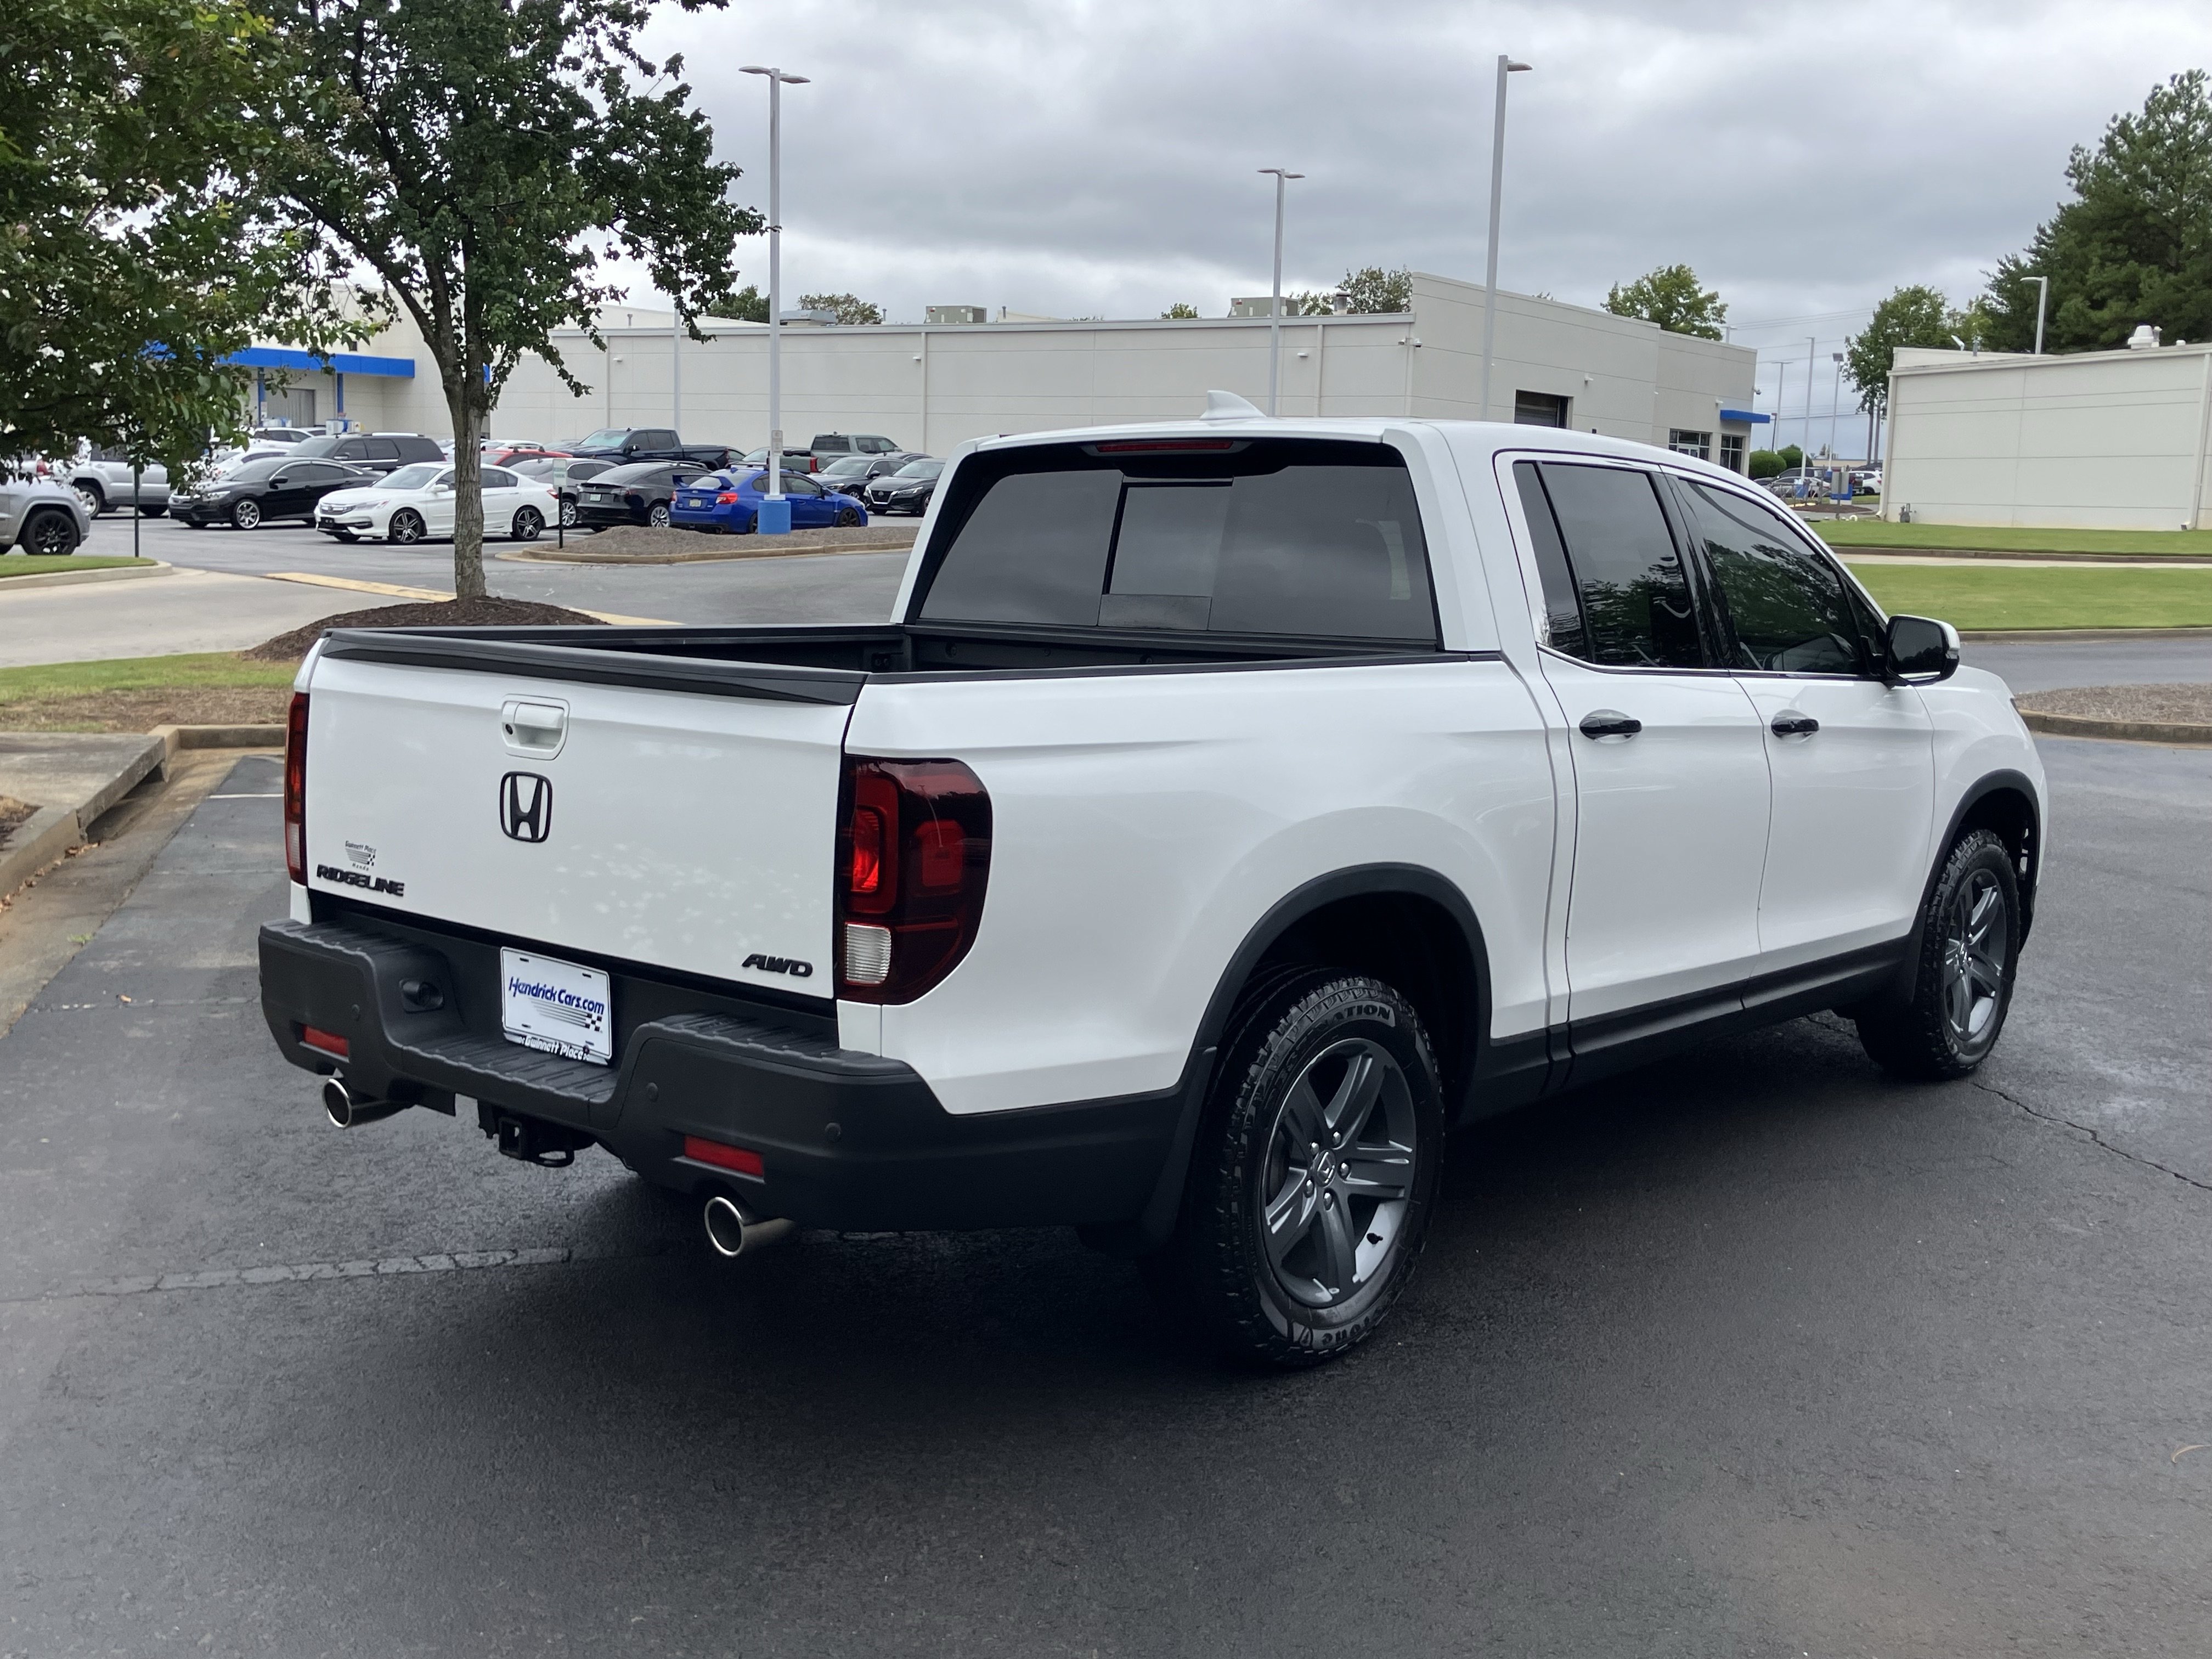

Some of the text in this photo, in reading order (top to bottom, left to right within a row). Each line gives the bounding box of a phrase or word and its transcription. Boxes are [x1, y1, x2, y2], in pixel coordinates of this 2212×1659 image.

[317, 864, 405, 896] RIDGELINE
[741, 953, 812, 977] AWD
[525, 1036, 584, 1060] Gwinnett Place
